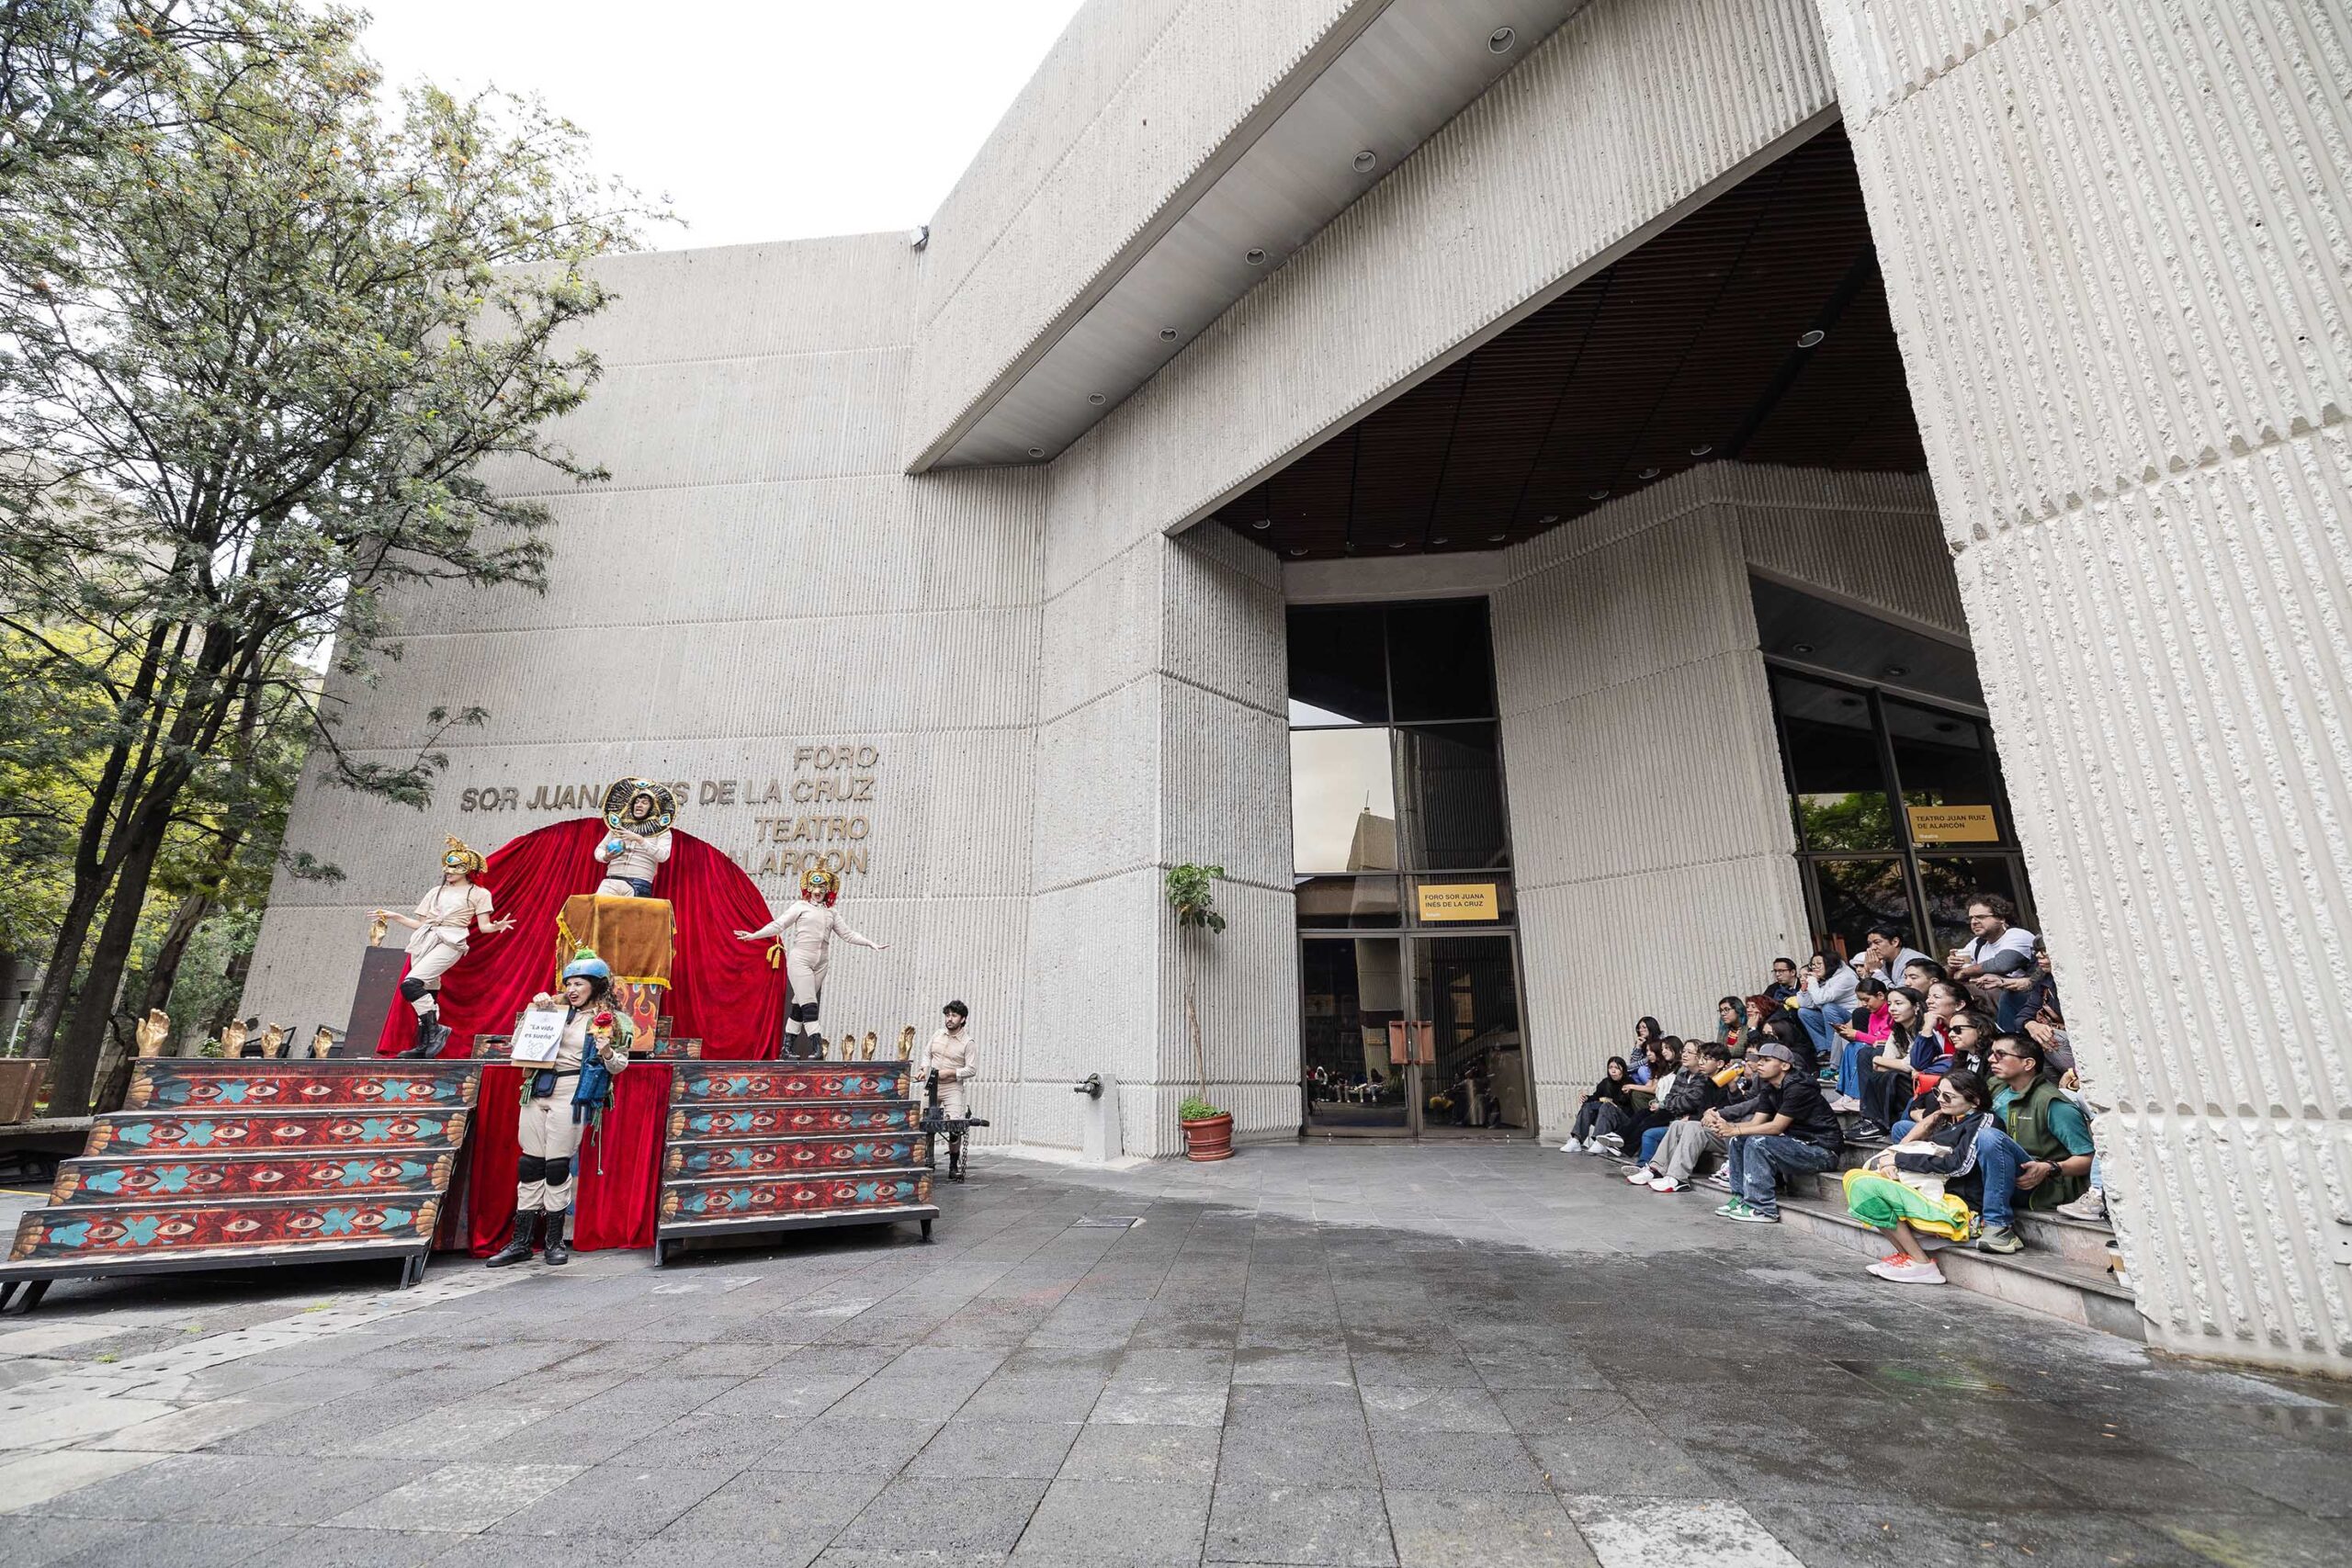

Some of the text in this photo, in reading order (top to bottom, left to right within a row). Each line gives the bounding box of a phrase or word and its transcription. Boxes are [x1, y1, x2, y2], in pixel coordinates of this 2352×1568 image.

[794, 745, 879, 771] FORO
[460, 786, 519, 812] SOR
[698, 780, 737, 806] DE
[745, 779, 782, 805] LA
[791, 776, 874, 803] CRUZ
[754, 815, 869, 842] TEATRO
